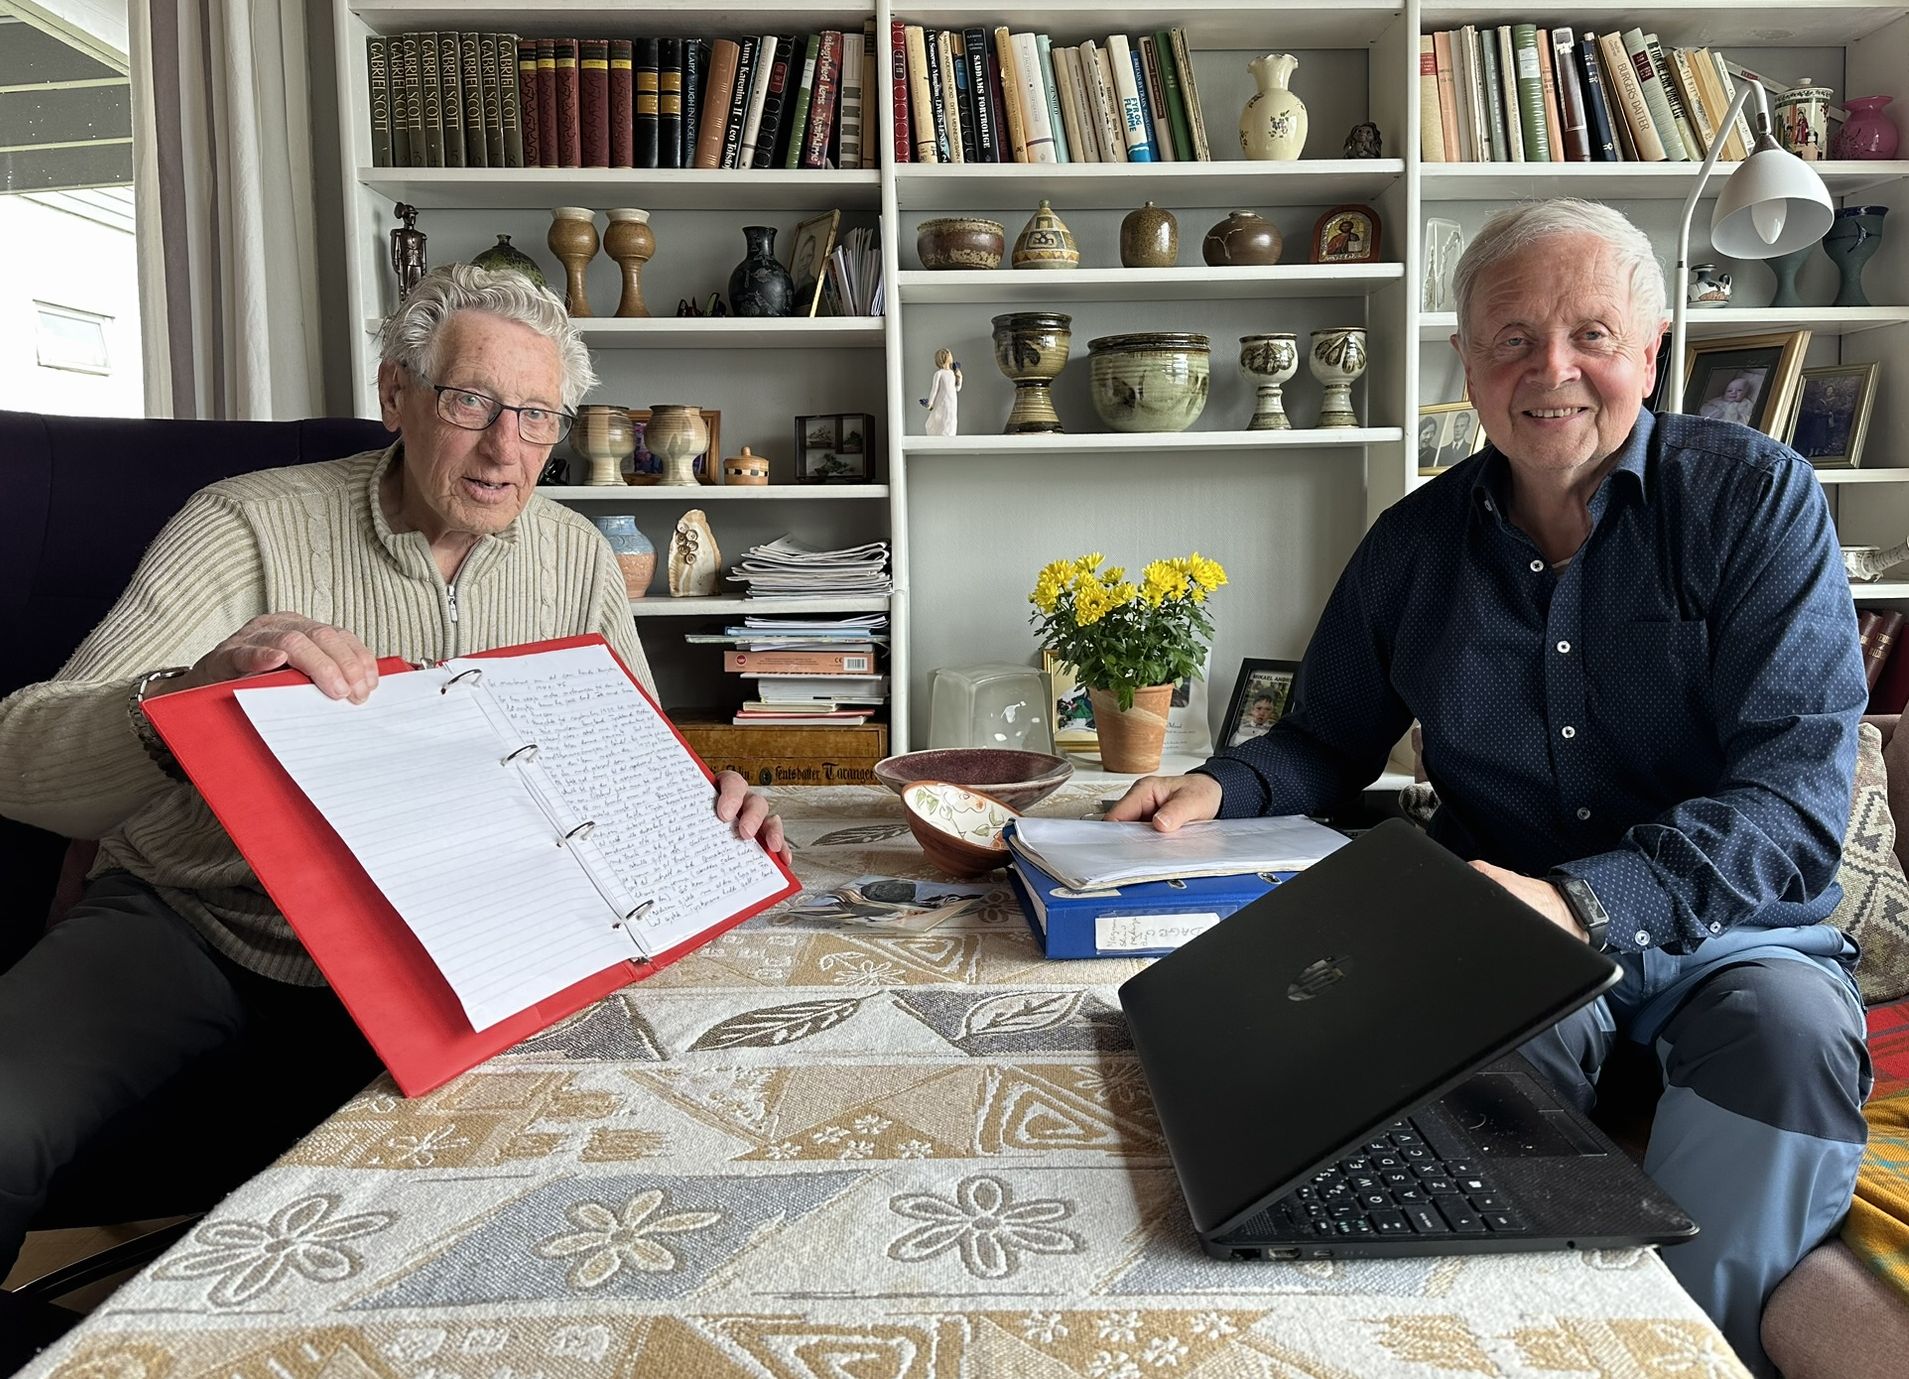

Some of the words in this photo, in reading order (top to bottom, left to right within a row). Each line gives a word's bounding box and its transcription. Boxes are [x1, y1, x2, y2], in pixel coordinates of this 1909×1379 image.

[370, 42, 386, 93] GABRIEL
[390, 42, 405, 93] GABRIEL
[403, 39, 418, 91] GABRIEL
[421, 39, 437, 91] GABRIEL
[441, 39, 456, 89] GABRIEL
[462, 40, 477, 92] GABRIEL
[480, 39, 496, 90] GABRIEL
[498, 41, 514, 91] GABRIEL
[741, 41, 753, 64] Anna
[819, 35, 835, 81] siegfried
[929, 43, 937, 67] Somerset
[1133, 58, 1142, 80] BRITAIN
[734, 67, 749, 104] Karenina
[931, 69, 940, 97] Maugham
[973, 55, 984, 94] SADDAMS
[1137, 81, 1143, 89] BY
[374, 93, 388, 133] SCOTT
[407, 91, 421, 130] SCOTT
[425, 91, 440, 130] SCOTT
[444, 91, 458, 130] SCOTT
[466, 93, 481, 131] SCOTT
[484, 91, 499, 130] SCOTT
[502, 92, 516, 131] SCOTT
[733, 107, 743, 116] II
[944, 56, 952, 82] ANDERSEN
[951, 118, 961, 159] MENNESKEBARN
[1123, 98, 1136, 132] FLAMME
[1130, 98, 1140, 113] FYR
[1138, 90, 1147, 108] TRAIN
[1617, 63, 1639, 100] BURGERS
[1632, 101, 1650, 132] DATTER
[1669, 107, 1685, 120] LIV
[728, 125, 739, 141] Leo
[977, 96, 990, 148] FORTROLIGE
[1134, 115, 1142, 126] OG
